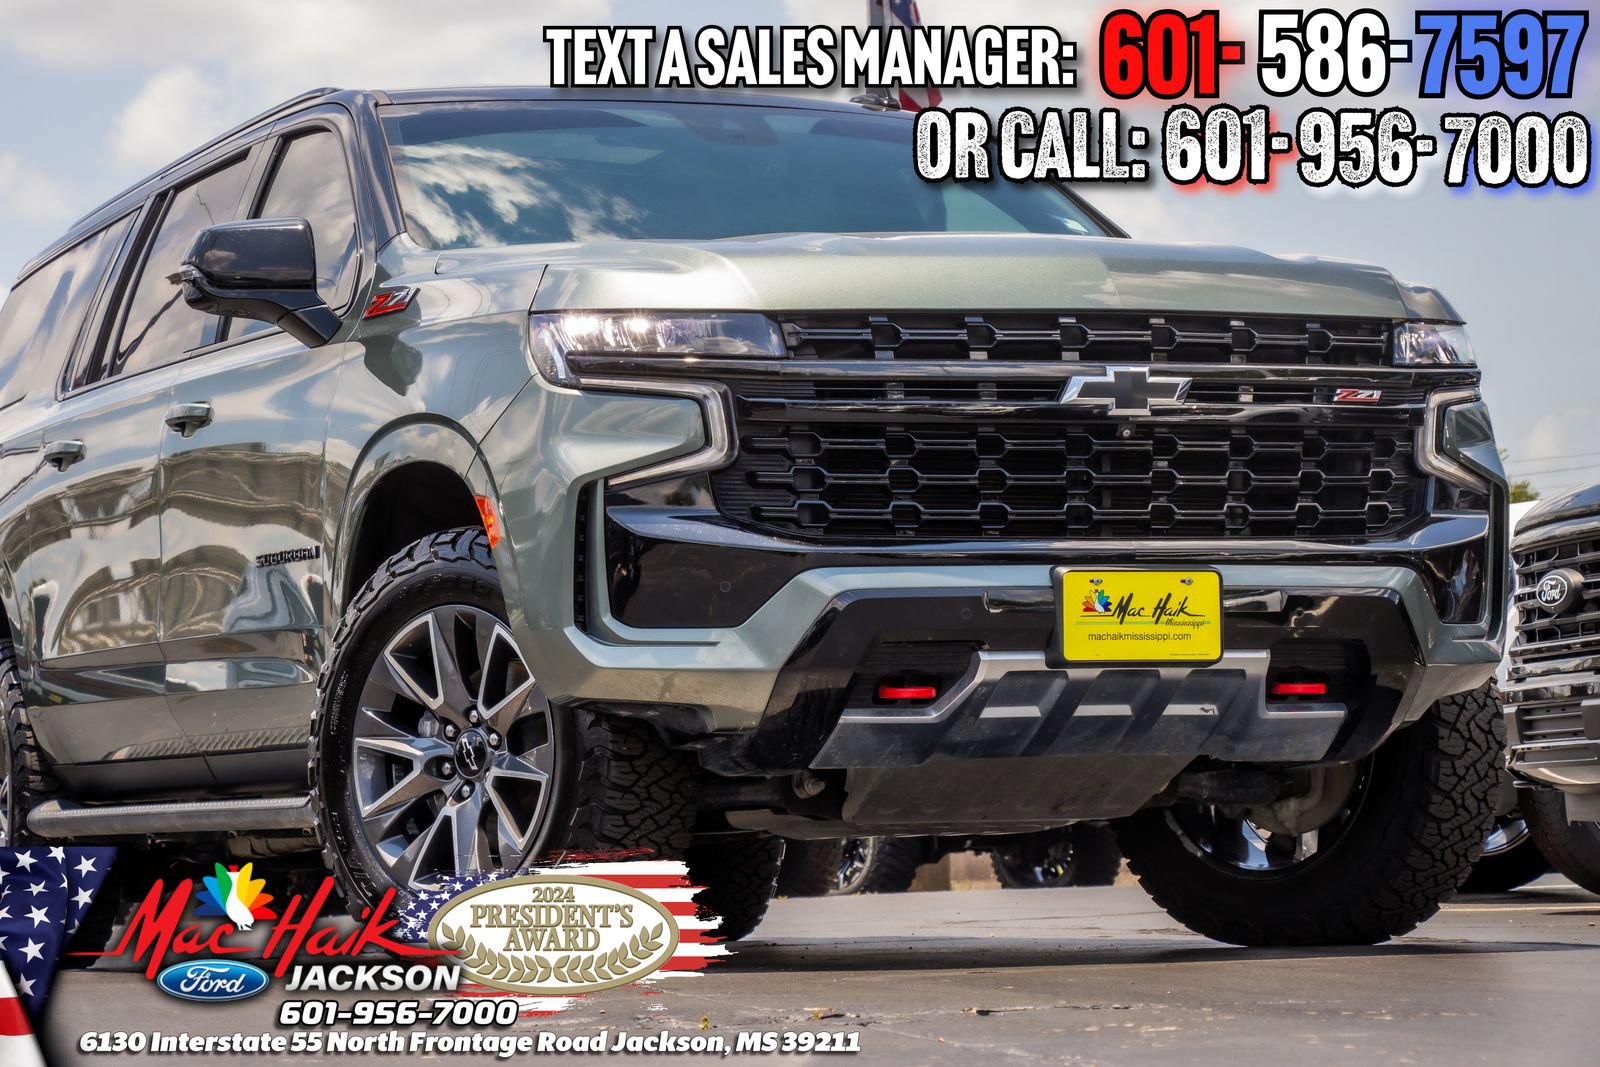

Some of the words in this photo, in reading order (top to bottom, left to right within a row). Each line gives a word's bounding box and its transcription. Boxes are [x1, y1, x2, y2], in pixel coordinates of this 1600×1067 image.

[256, 546, 320, 568] SUBURBAN
[1541, 580, 1561, 601] Ford
[1110, 592, 1145, 625] Mac
[1152, 592, 1198, 625] Haik
[1165, 617, 1204, 629] Mississippi
[1088, 631, 1192, 642] machaikmississippi.com
